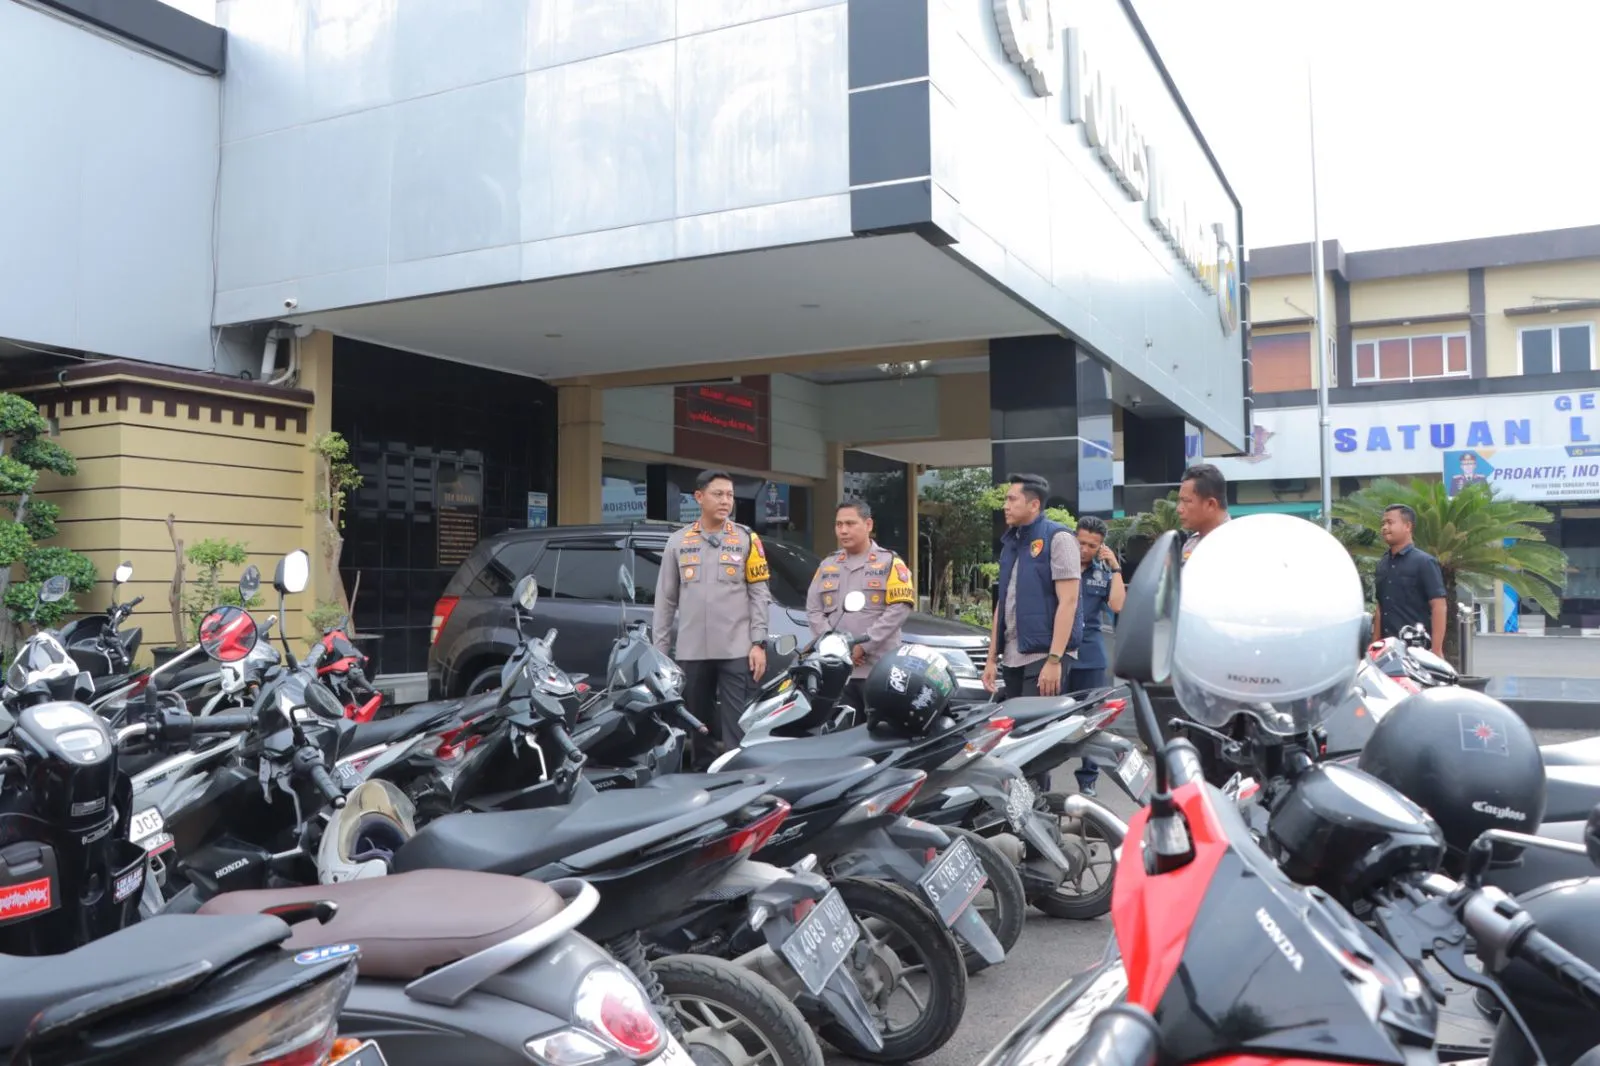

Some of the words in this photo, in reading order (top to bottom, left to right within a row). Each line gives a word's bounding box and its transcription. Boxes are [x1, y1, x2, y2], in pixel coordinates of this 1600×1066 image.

[1334, 418, 1531, 452] SATUAN
[1570, 416, 1591, 442] L
[1493, 466, 1566, 480] PROAKTIF,
[1227, 673, 1282, 685] HONDA
[135, 812, 161, 835] JCF
[214, 857, 250, 879] HONDA
[927, 884, 940, 902] S
[799, 917, 827, 957] 4089
[1255, 906, 1304, 973] HONDA
